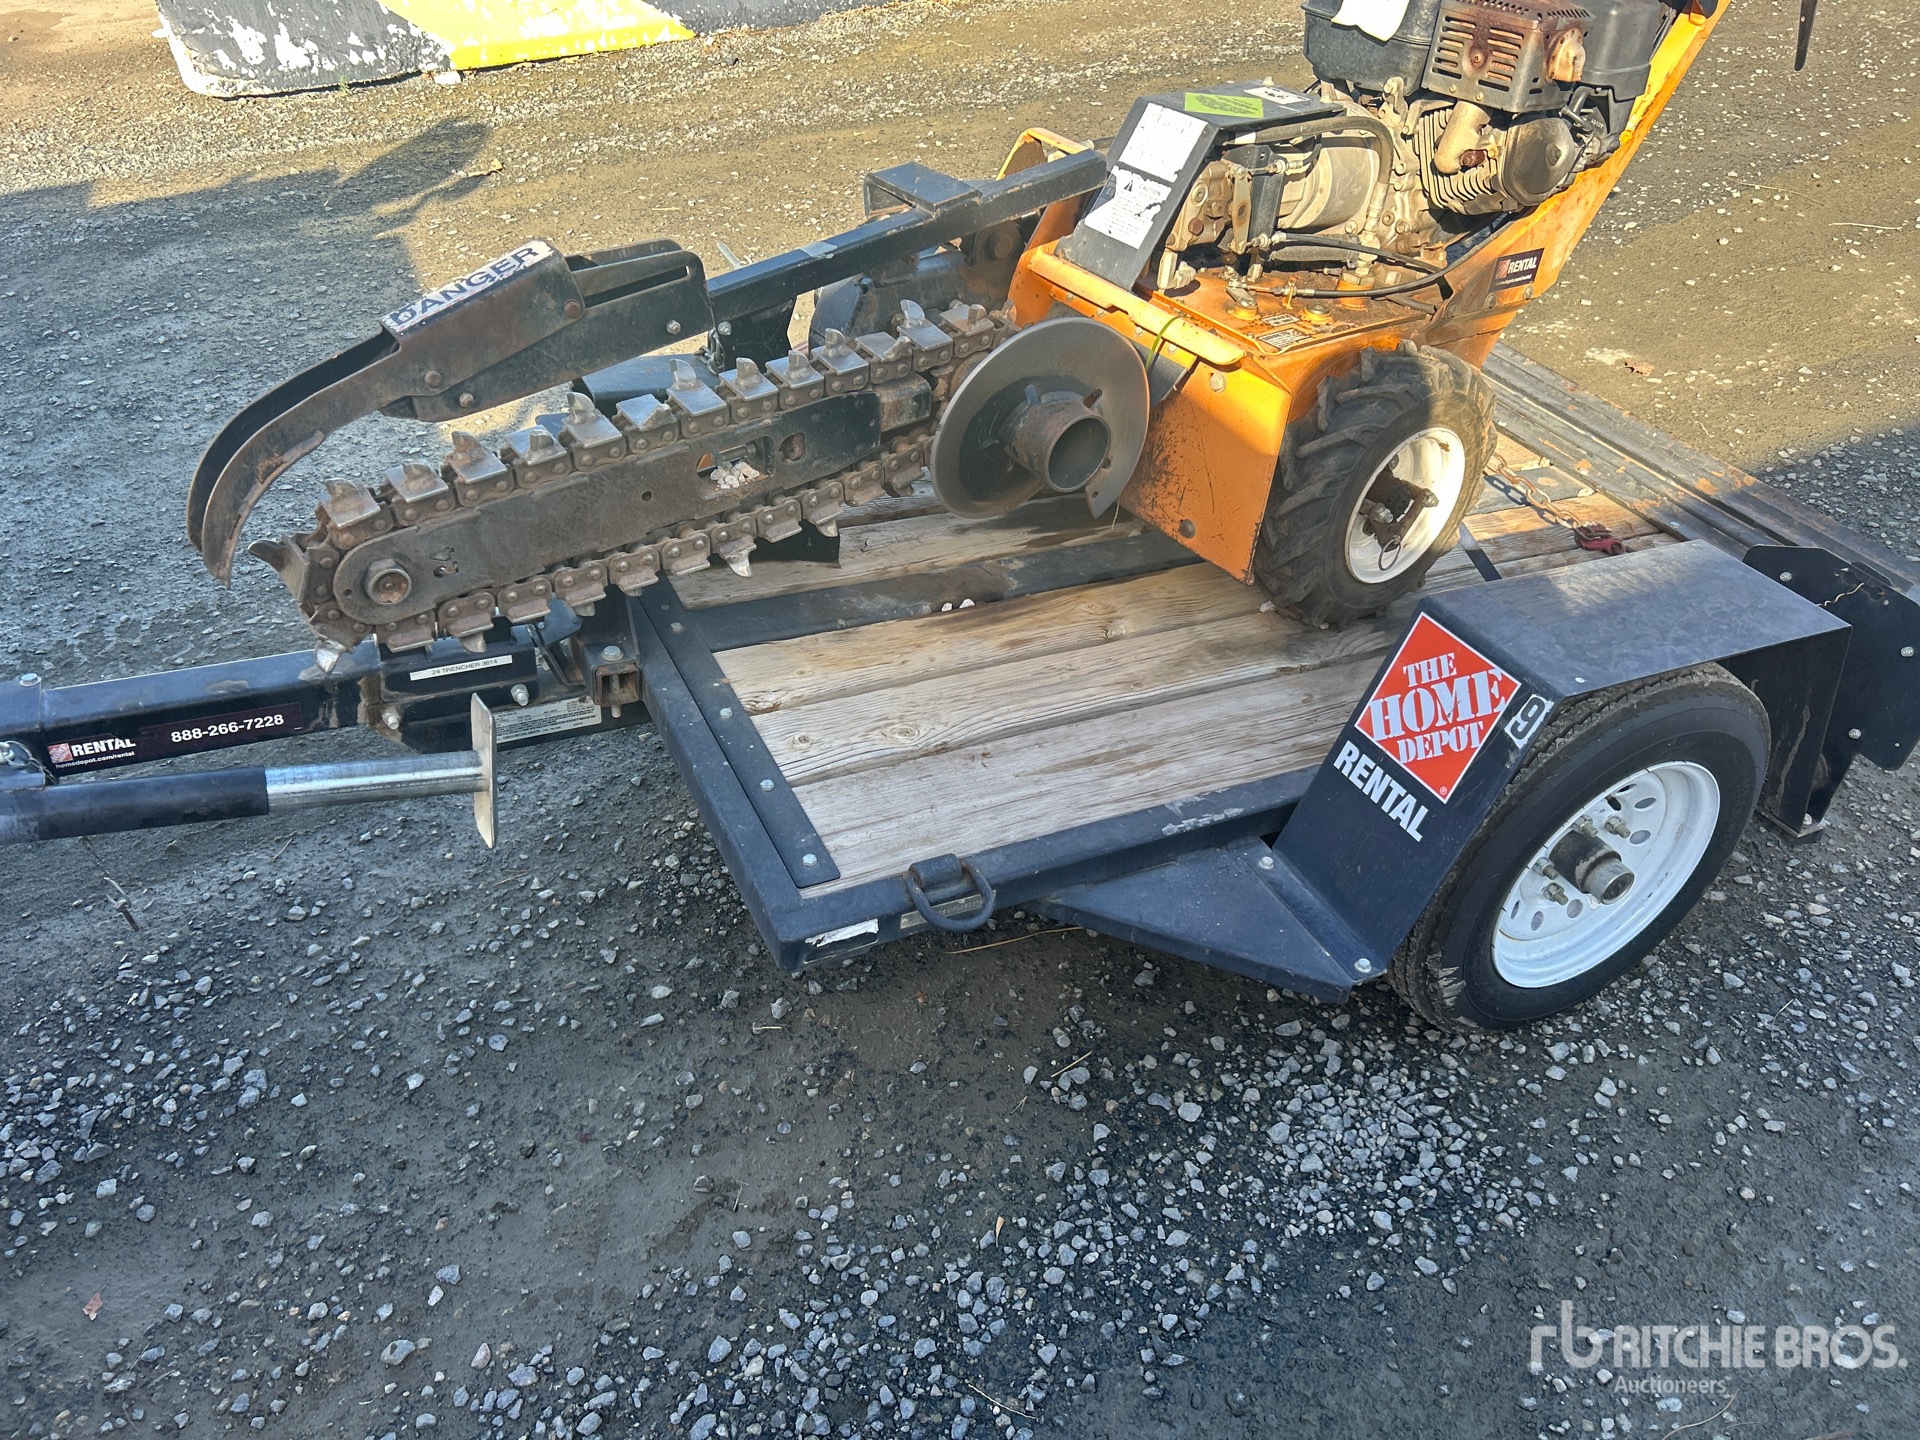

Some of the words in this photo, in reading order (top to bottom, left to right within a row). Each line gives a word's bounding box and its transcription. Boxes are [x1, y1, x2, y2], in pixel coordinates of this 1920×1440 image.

[1507, 256, 1537, 274] RENTAL
[389, 247, 540, 326] DANGER
[442, 663, 481, 674] TRENCHER
[1402, 652, 1458, 688] THE
[1368, 668, 1507, 742] HOME
[1510, 695, 1546, 740] 9
[170, 714, 284, 743] 888-266-7228
[1397, 721, 1484, 764] DEPOT
[54, 750, 135, 769] homedepot.com/rental
[70, 738, 136, 757] RENTAL
[1333, 740, 1429, 843] RENTAL
